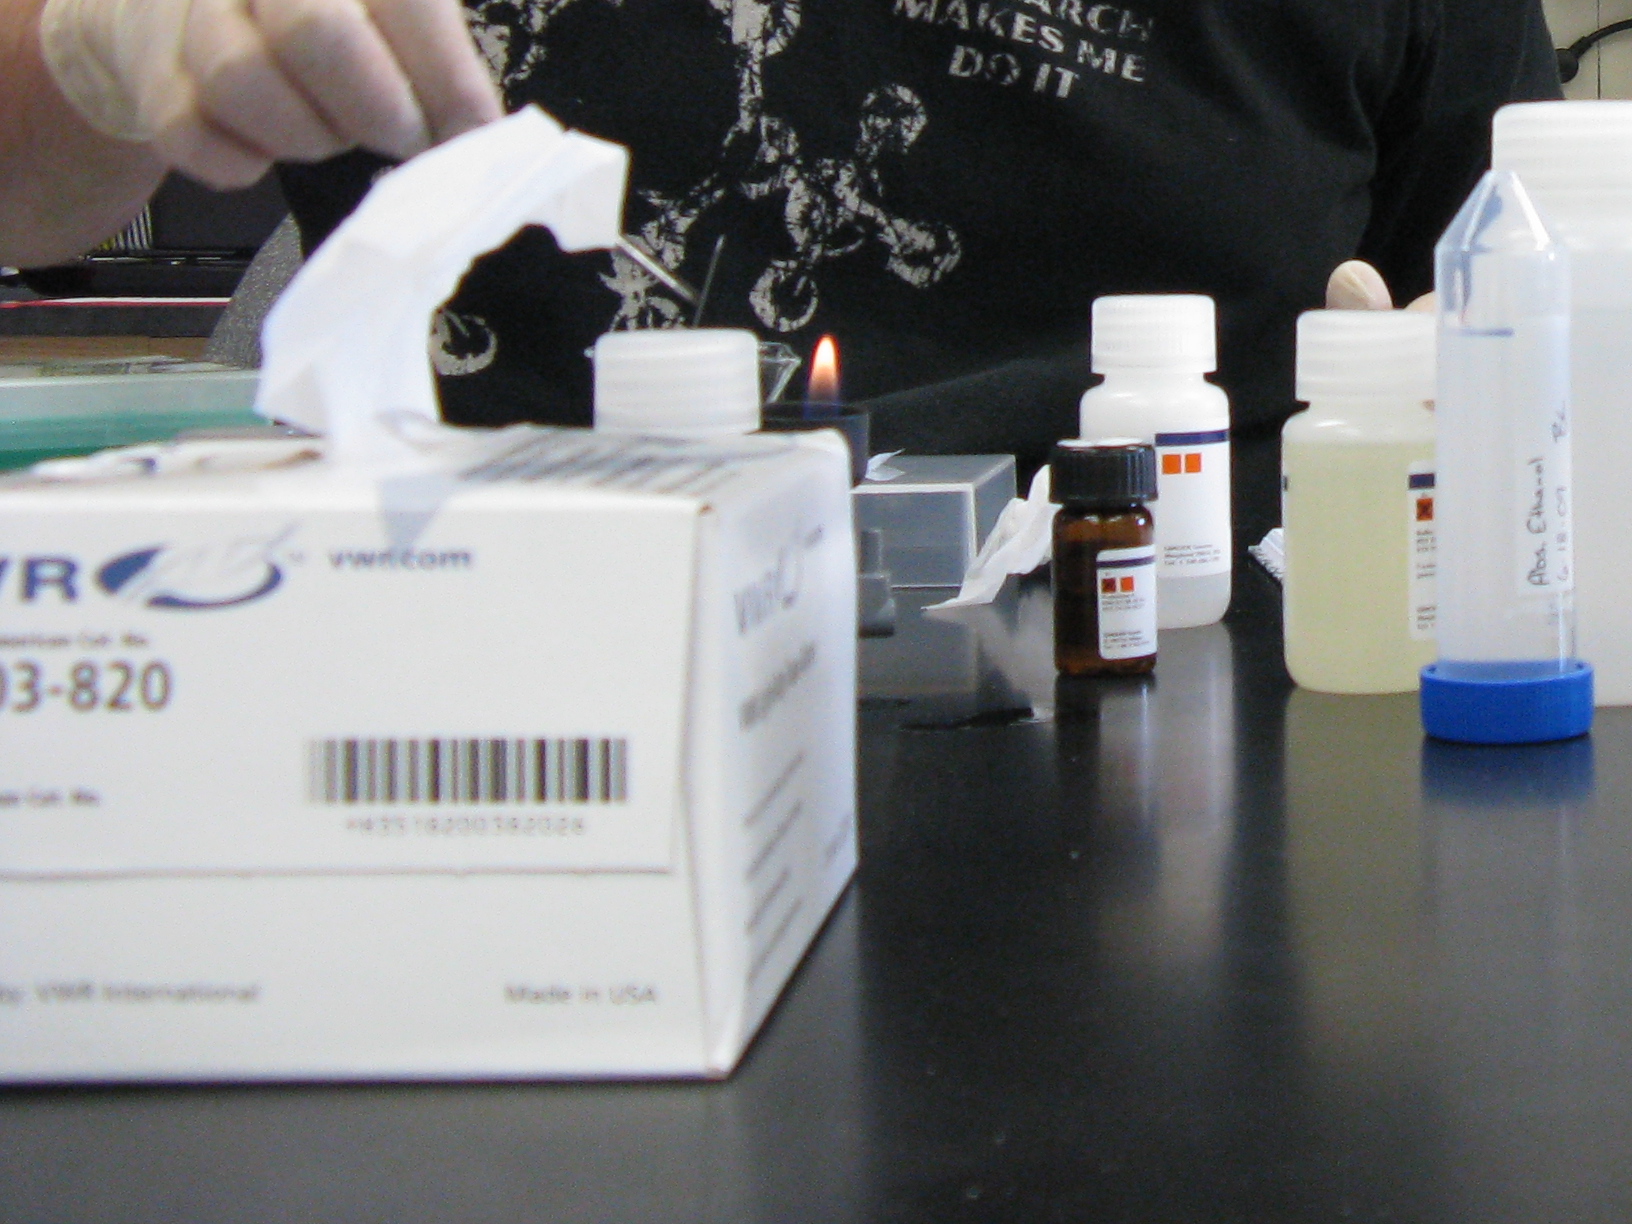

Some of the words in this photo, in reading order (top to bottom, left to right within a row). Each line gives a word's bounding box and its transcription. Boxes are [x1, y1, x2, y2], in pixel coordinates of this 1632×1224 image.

[948, 45, 1021, 86] DO
[1033, 62, 1079, 99] IT
[1077, 39, 1146, 82] ME
[0, 660, 172, 712] 3-820
[103, 982, 260, 1004] International
[504, 983, 572, 1006] Made
[579, 983, 600, 1005] in
[608, 983, 658, 1006] USA
